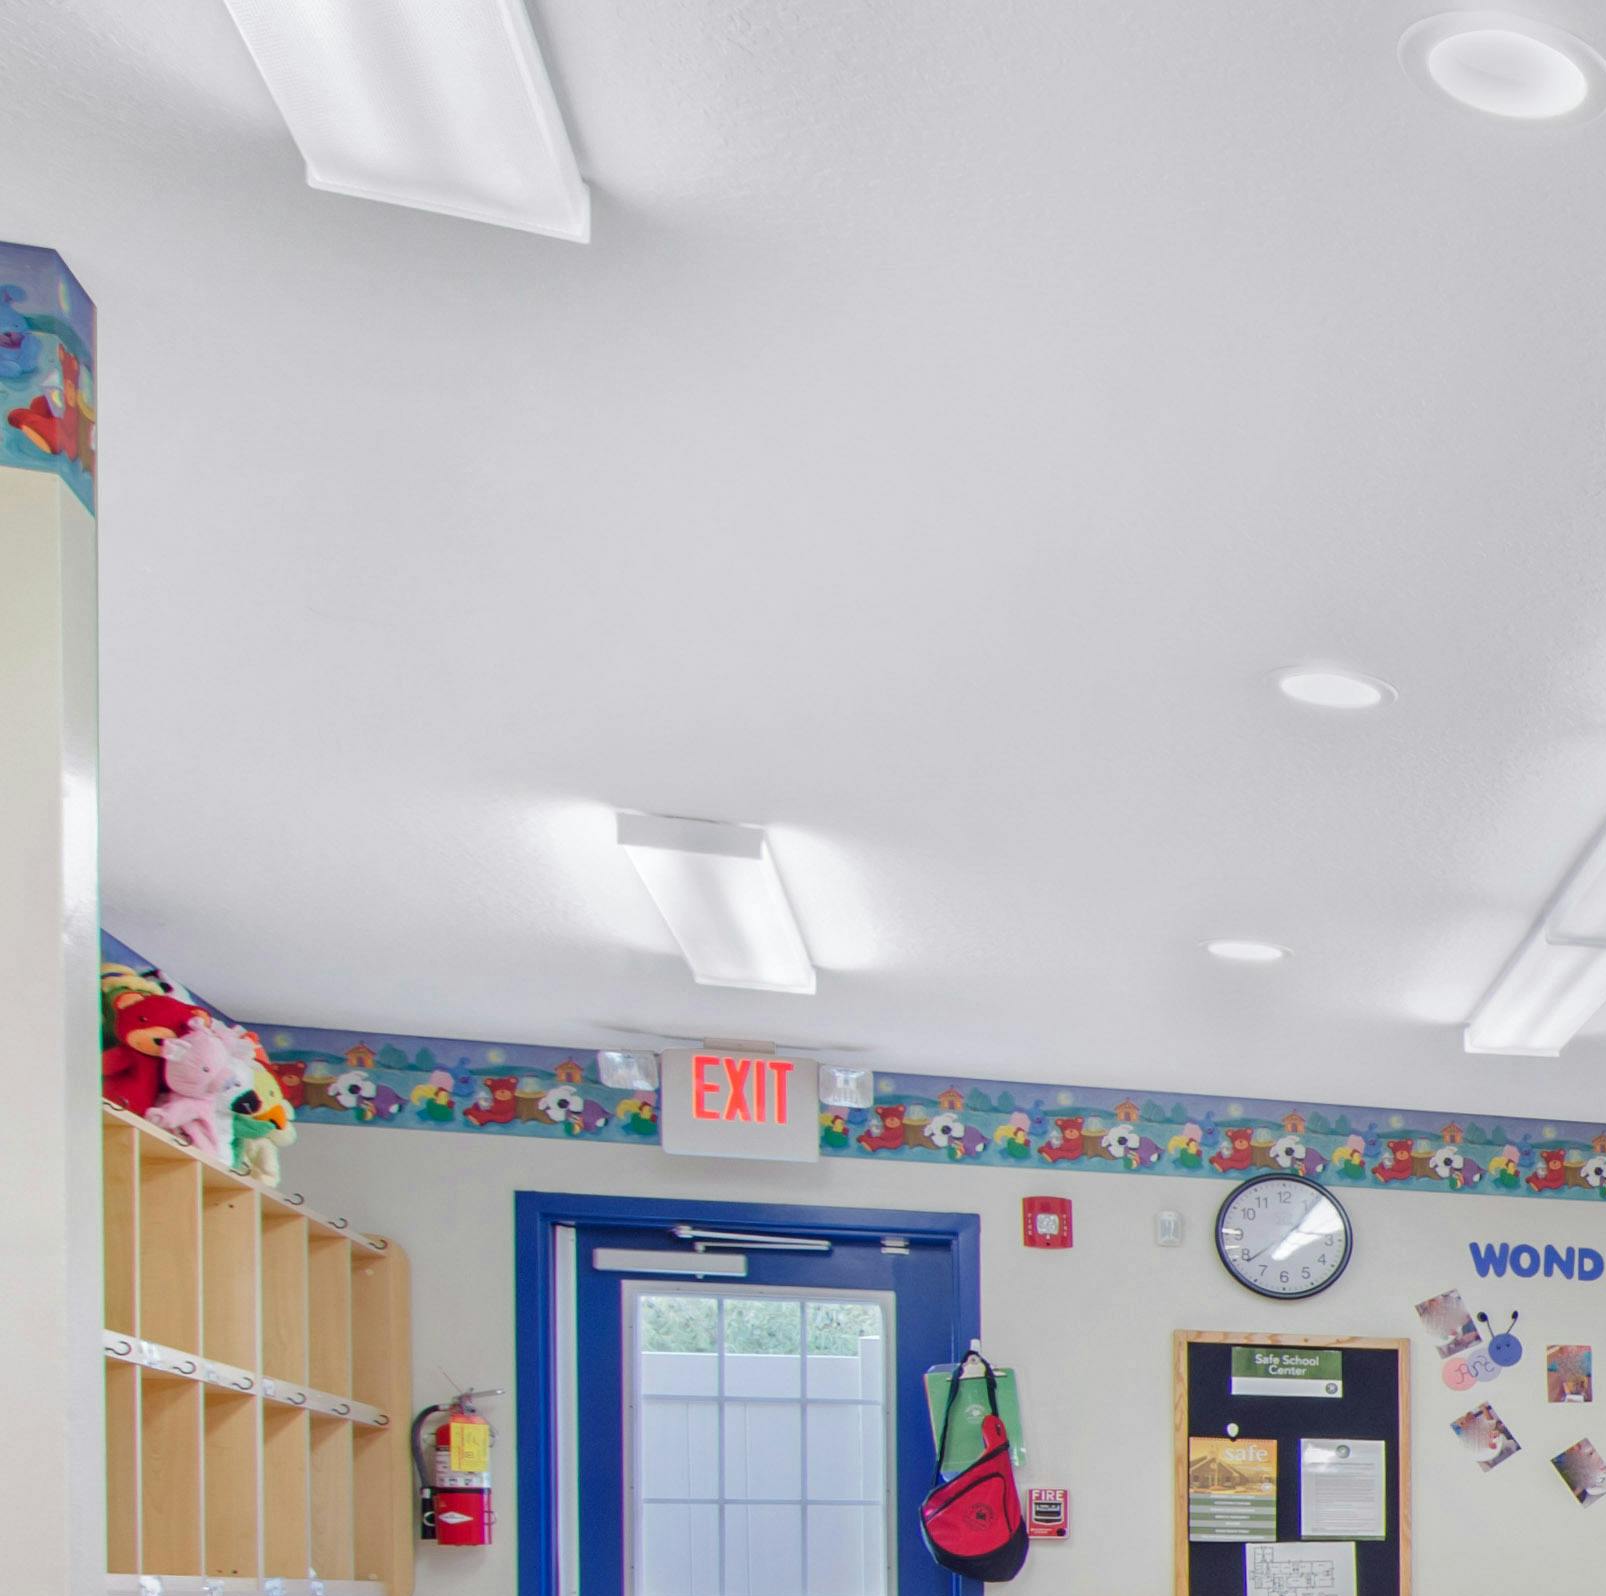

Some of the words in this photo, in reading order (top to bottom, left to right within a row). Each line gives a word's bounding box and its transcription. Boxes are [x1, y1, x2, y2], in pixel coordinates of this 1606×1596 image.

[693, 1055, 795, 1125] EXIT
[1255, 1196, 1268, 1209] 11
[1277, 1190, 1292, 1204] 12
[1241, 1206, 1257, 1221] 10
[1324, 1232, 1335, 1247] 3
[1241, 1248, 1251, 1261] 8
[1317, 1253, 1328, 1266] 4
[1258, 1264, 1269, 1277] 7
[1279, 1270, 1289, 1283] 6
[1301, 1266, 1312, 1280] 5
[1255, 1354, 1279, 1364] Safe
[1282, 1355, 1319, 1366] School
[1268, 1364, 1307, 1375] Center
[1454, 1355, 1495, 1385] Art
[1223, 1444, 1268, 1462] safe
[1031, 1489, 1064, 1501] FIRE
